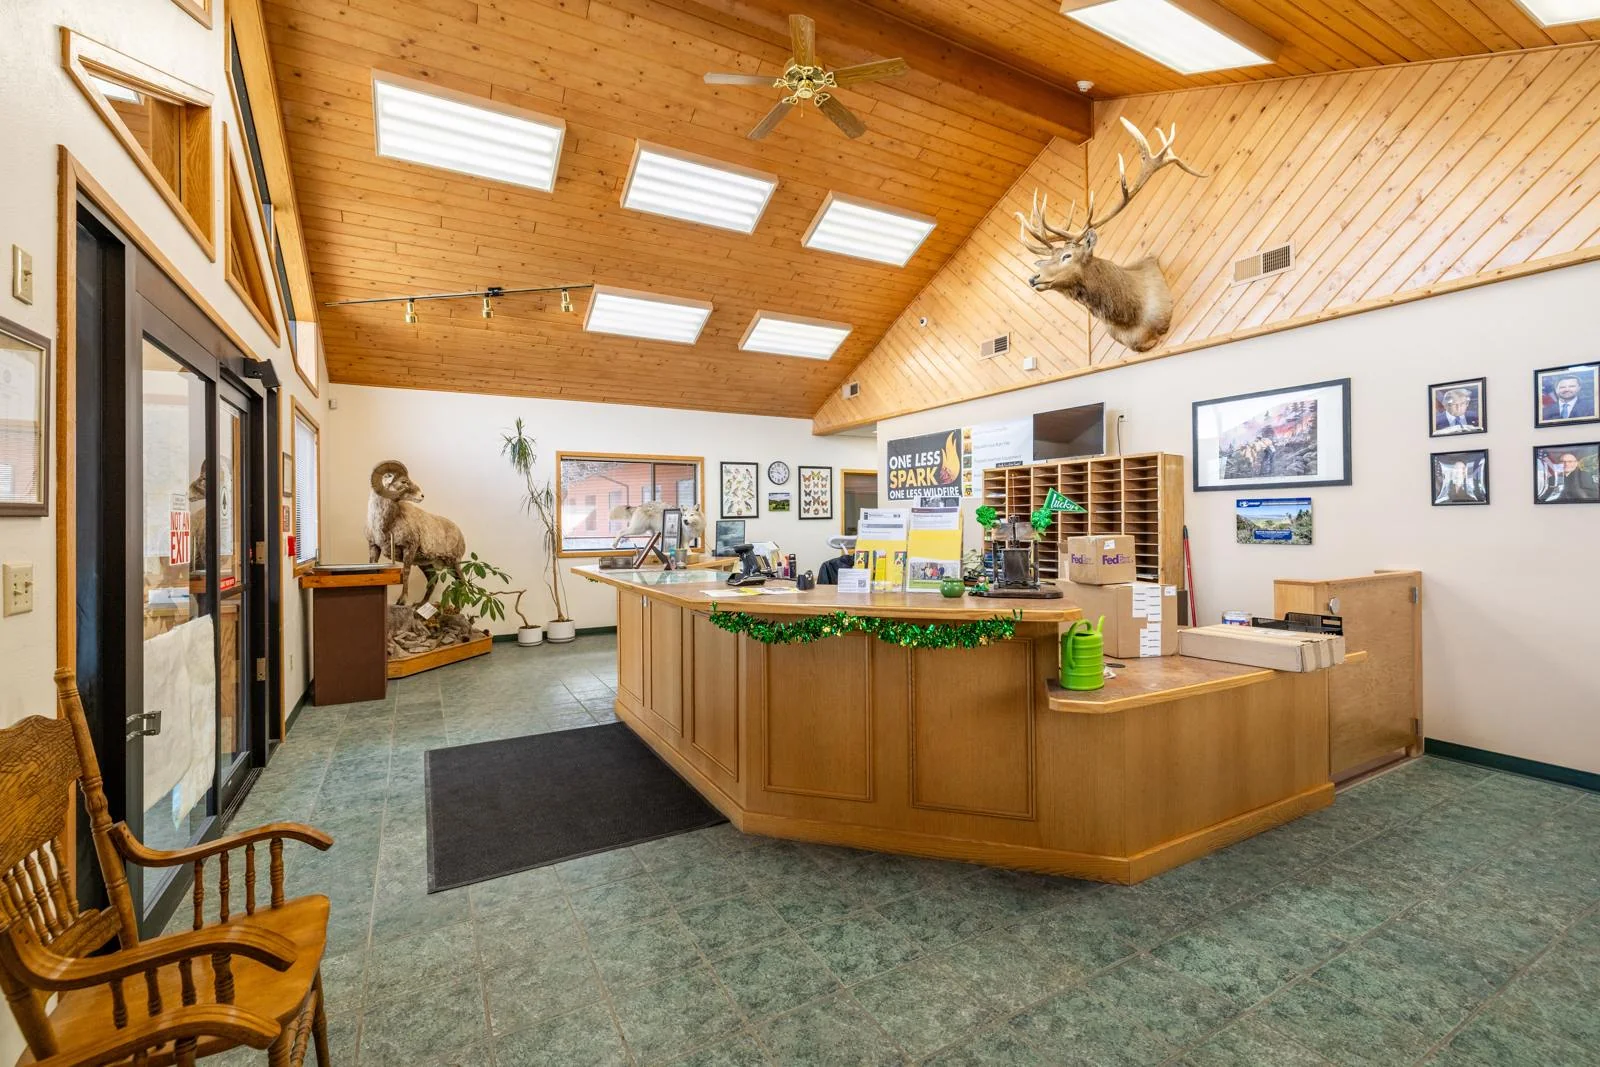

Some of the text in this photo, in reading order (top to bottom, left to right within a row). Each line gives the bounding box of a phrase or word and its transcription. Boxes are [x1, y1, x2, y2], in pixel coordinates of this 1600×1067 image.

[889, 450, 941, 469] ONE LESS
[889, 466, 939, 489] SPARK
[889, 486, 960, 499] ONE LESS WILDFIRE
[170, 511, 190, 530] NOT AN
[170, 531, 190, 564] EXIT
